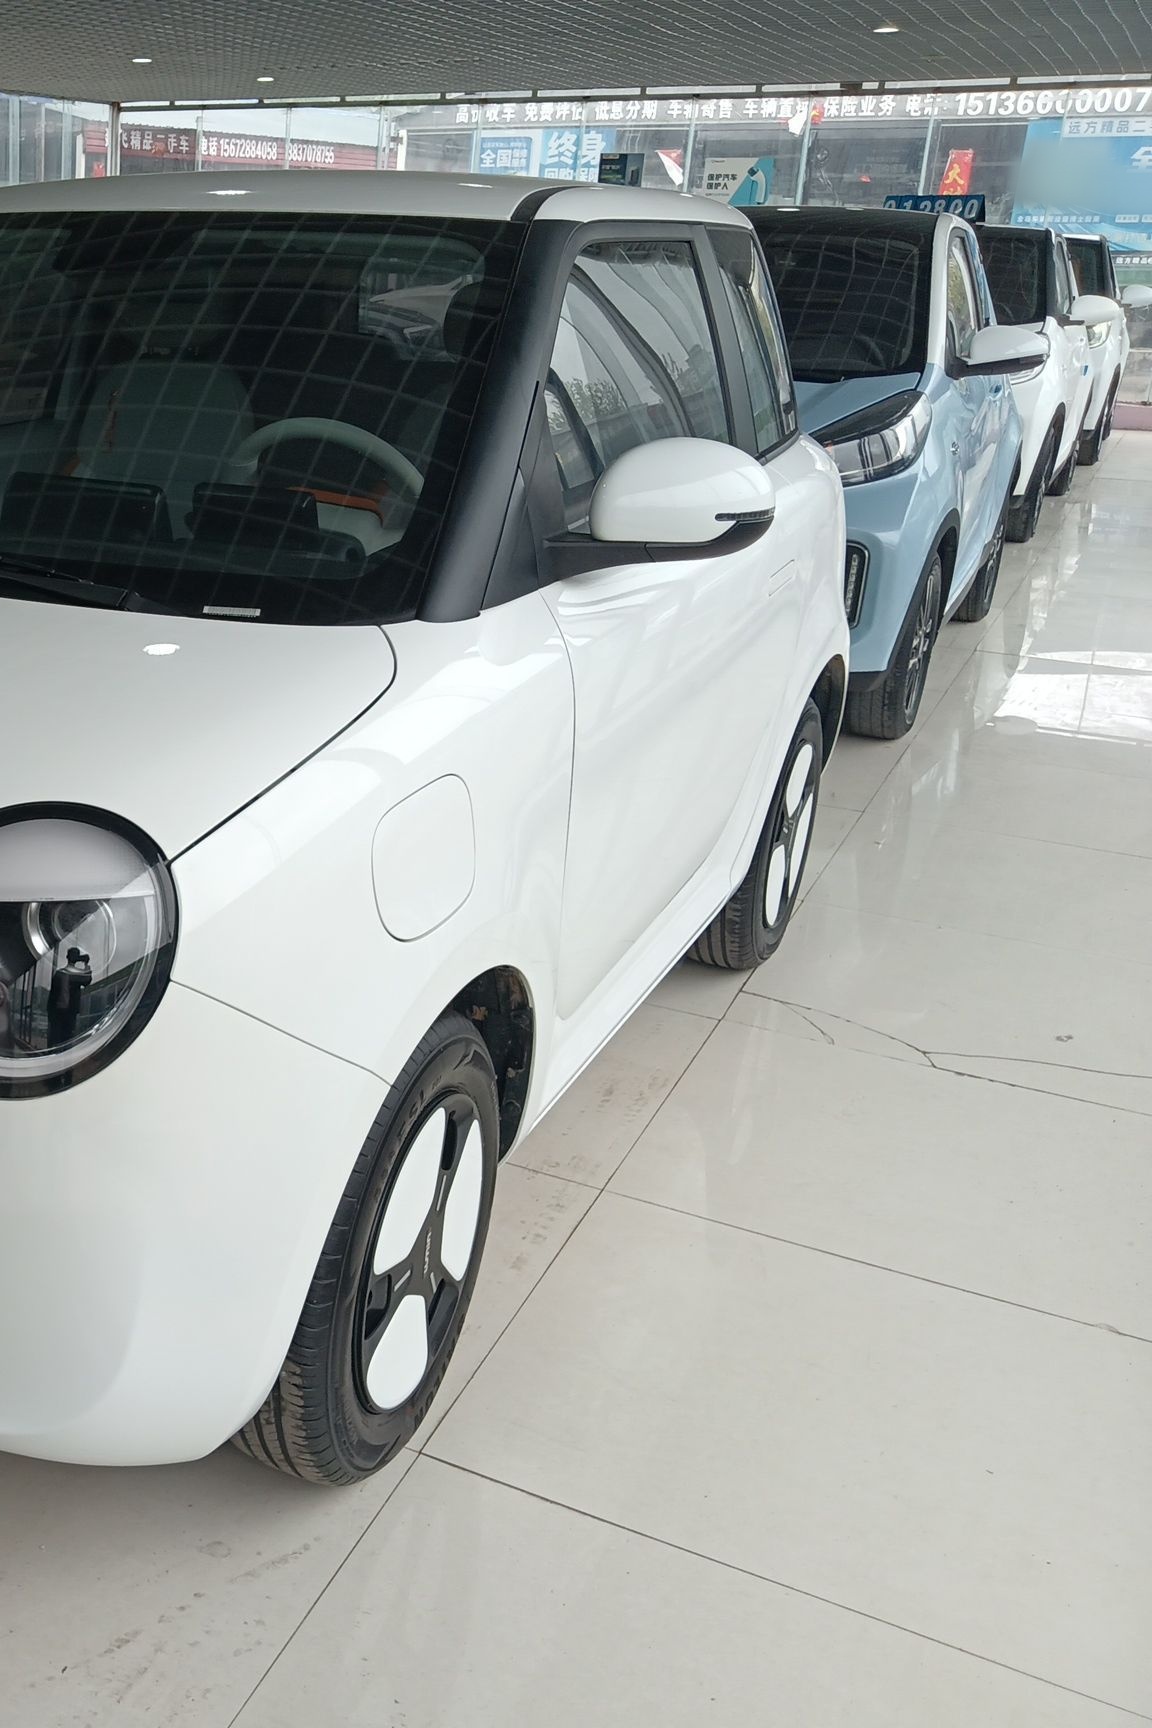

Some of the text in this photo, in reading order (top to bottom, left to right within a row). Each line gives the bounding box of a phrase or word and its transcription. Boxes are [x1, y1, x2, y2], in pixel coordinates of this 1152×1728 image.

[594, 100, 658, 120] 低息分期
[823, 95, 896, 117] 保险业务
[1068, 120, 1152, 134] 远方精品二
[201, 136, 218, 156] 电话
[544, 130, 606, 166] 终身
